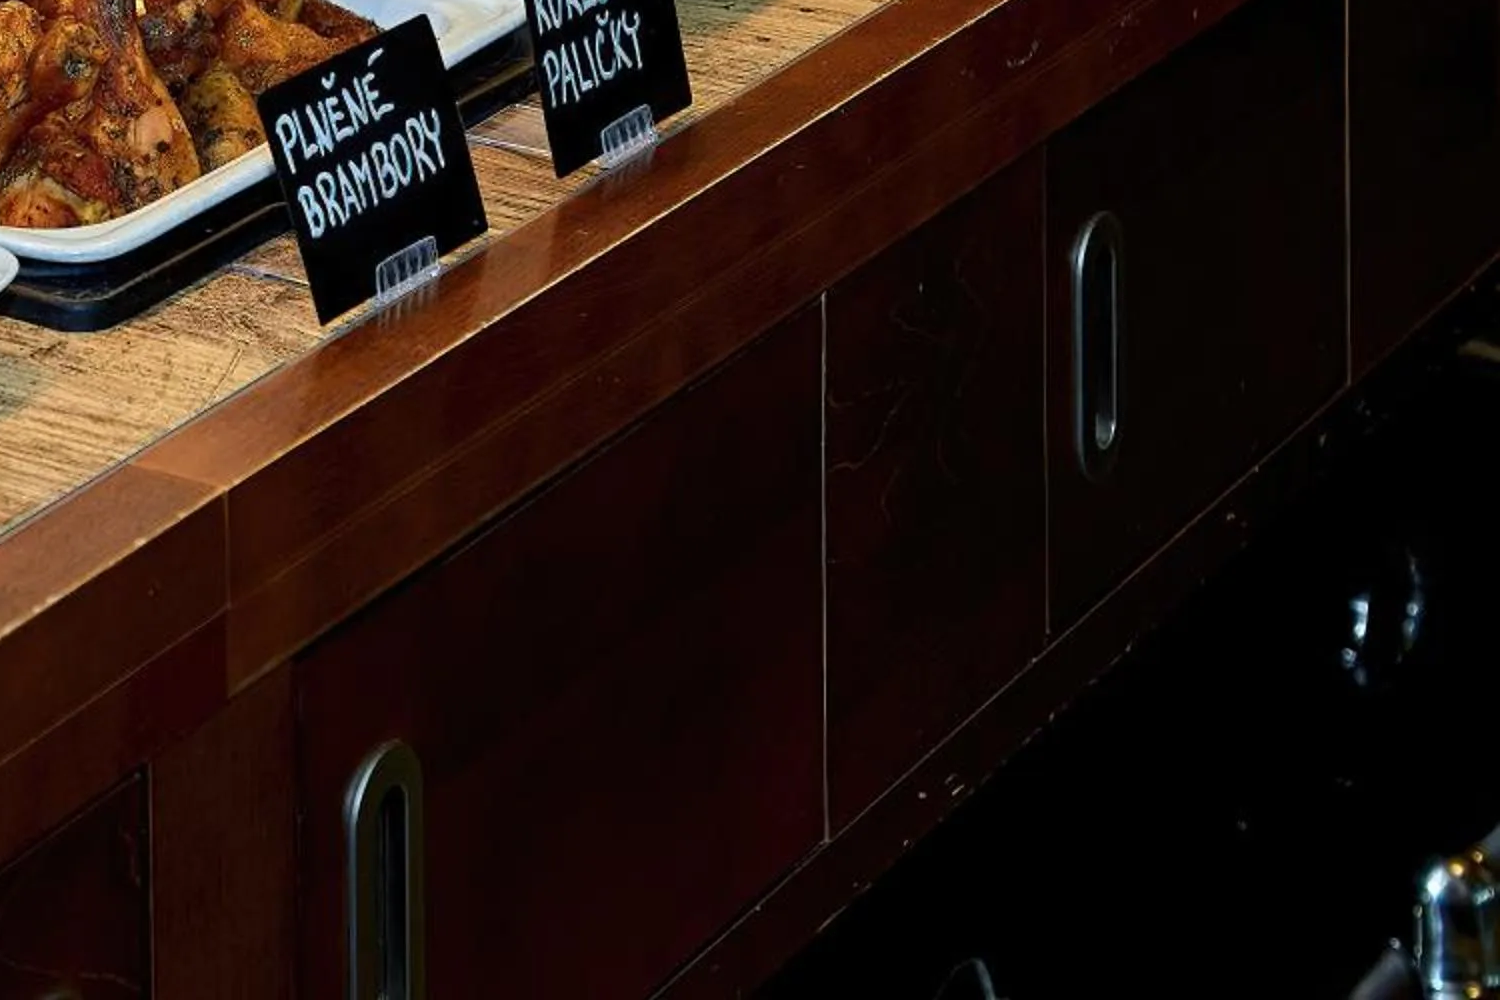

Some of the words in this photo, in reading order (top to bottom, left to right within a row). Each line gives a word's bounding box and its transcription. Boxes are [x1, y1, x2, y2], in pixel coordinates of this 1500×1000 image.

[275, 48, 394, 175] PLNĚNÉ
[543, 9, 643, 108] PALIČKY
[297, 107, 446, 239] BRAMBORY
